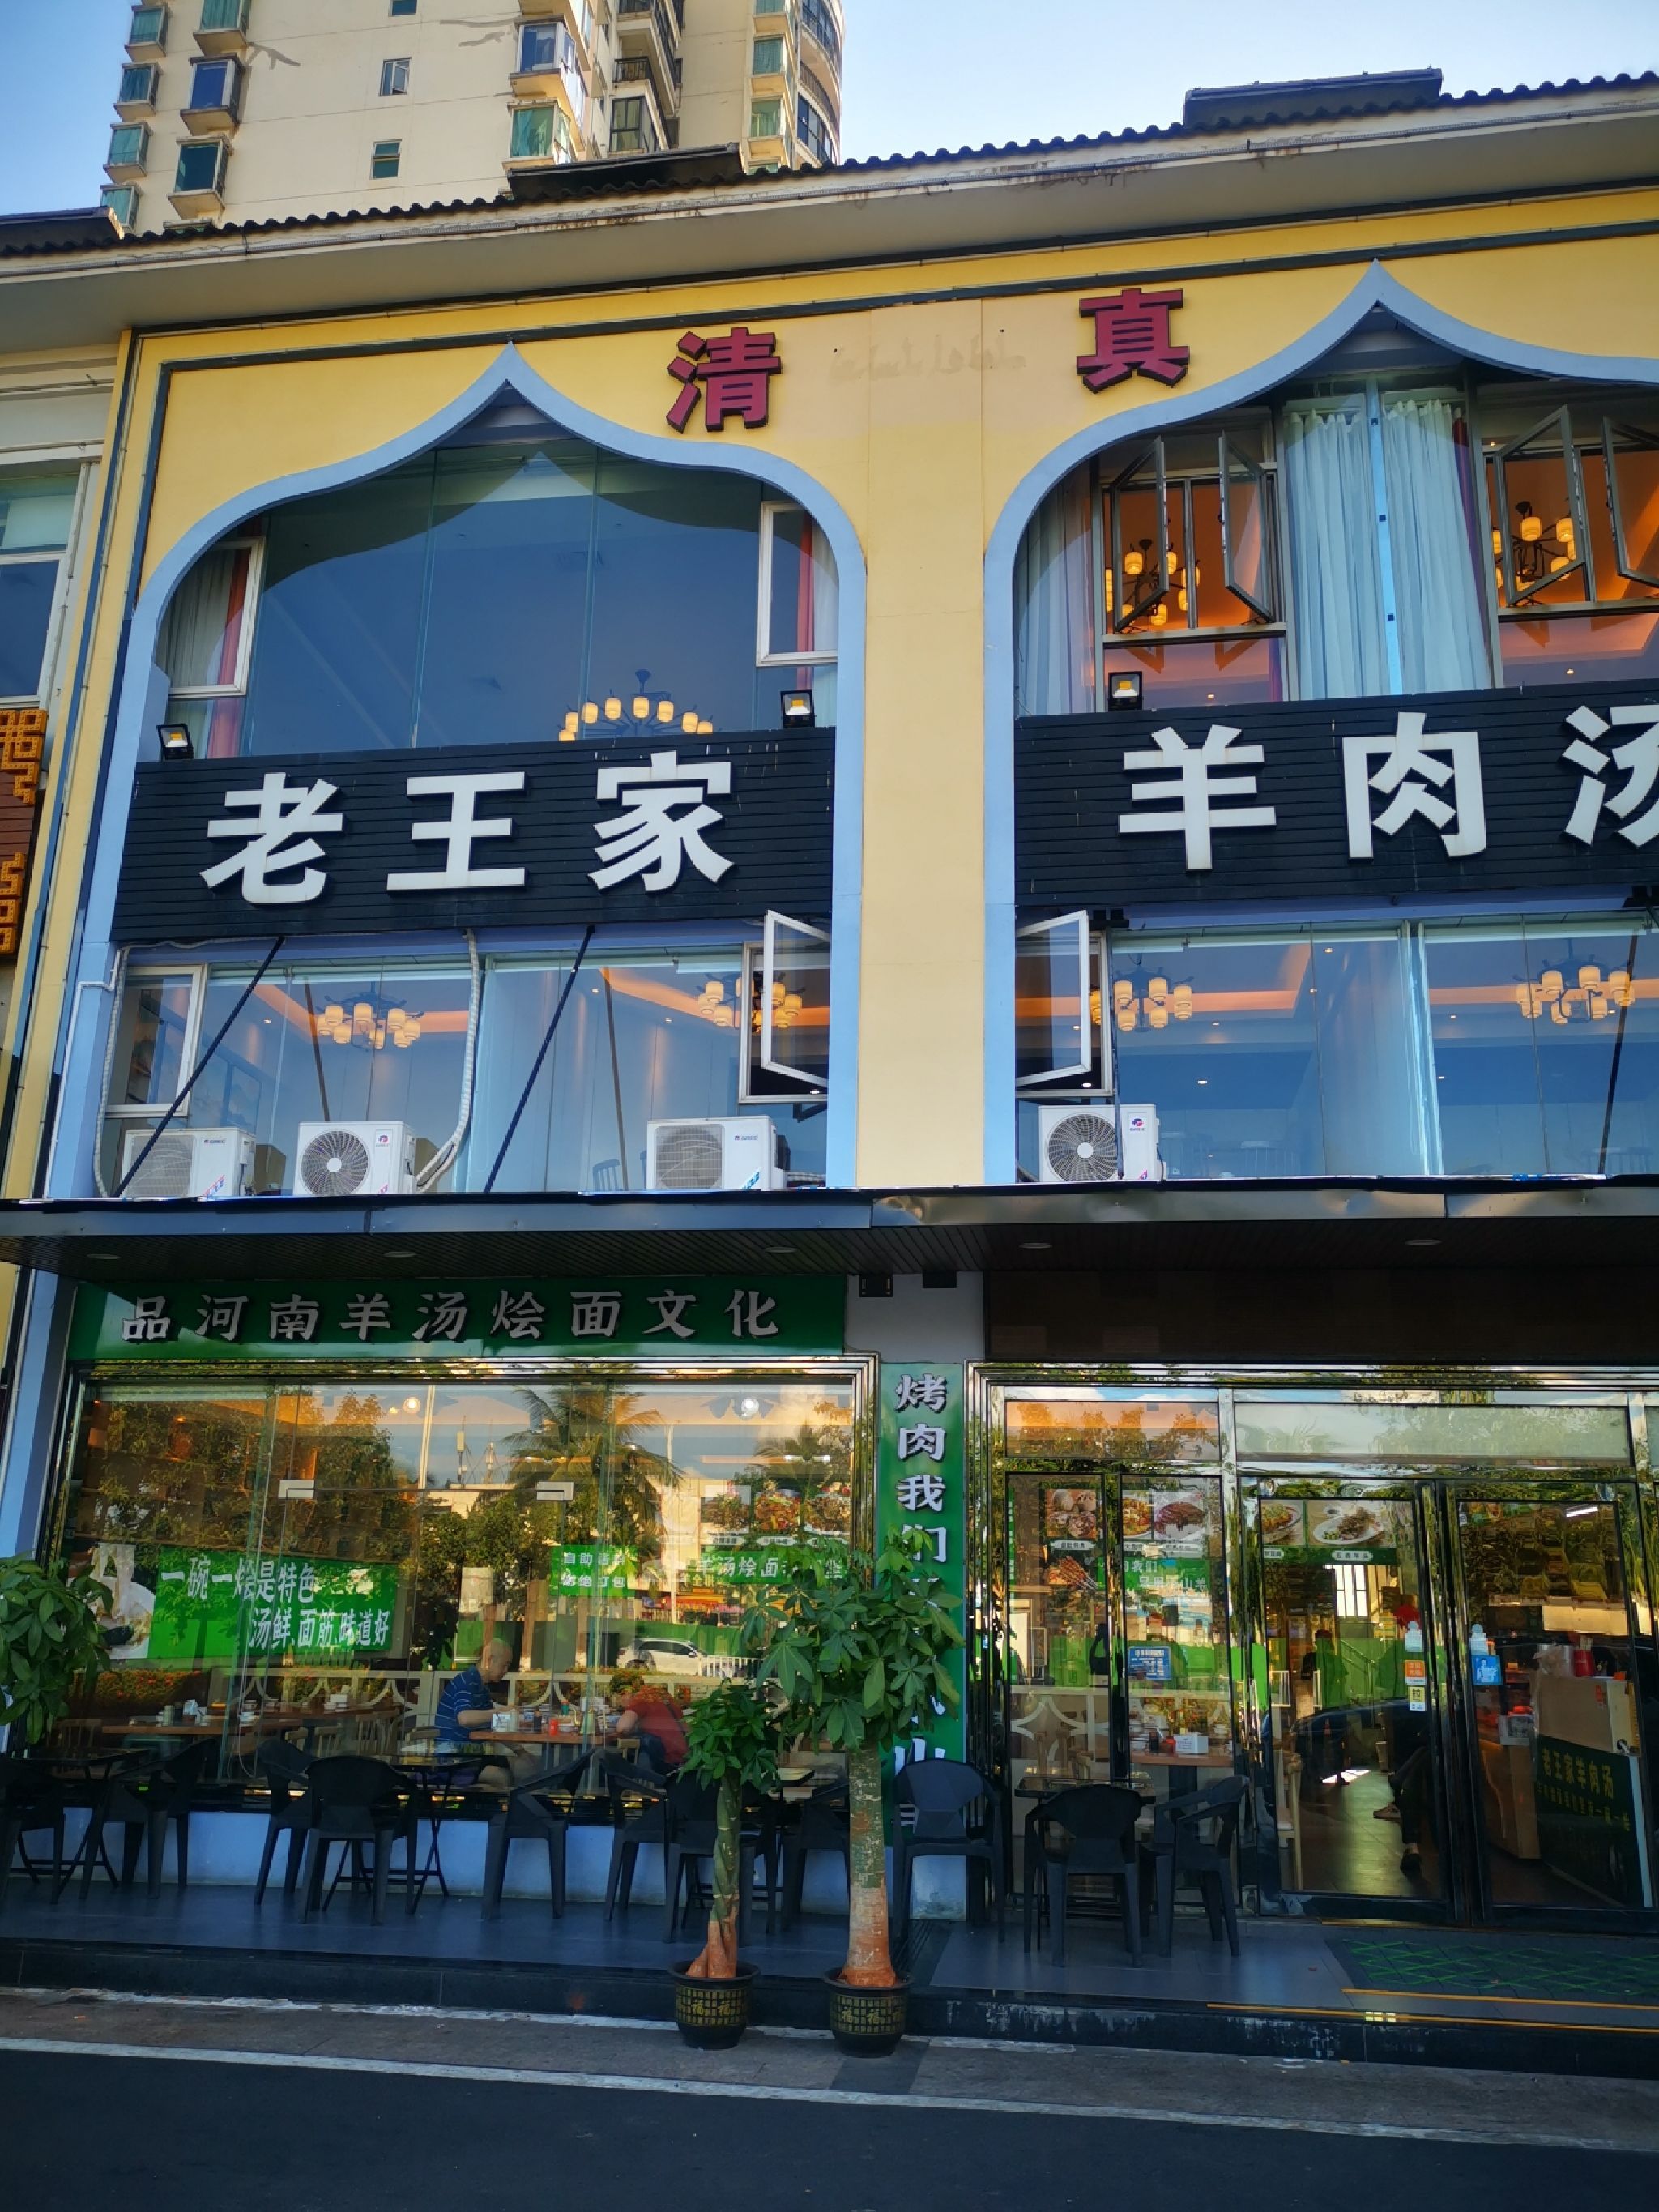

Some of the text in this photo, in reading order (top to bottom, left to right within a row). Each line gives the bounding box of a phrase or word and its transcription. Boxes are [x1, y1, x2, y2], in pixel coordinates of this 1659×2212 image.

[667, 327, 781, 433] 清
[1076, 288, 1190, 394] 真
[200, 752, 736, 904] 老王家
[1118, 705, 1659, 871] 羊肉汤
[122, 1290, 779, 1342] 品河南羊汤烩面文化
[160, 1556, 316, 1605] 一碗一烩是特色
